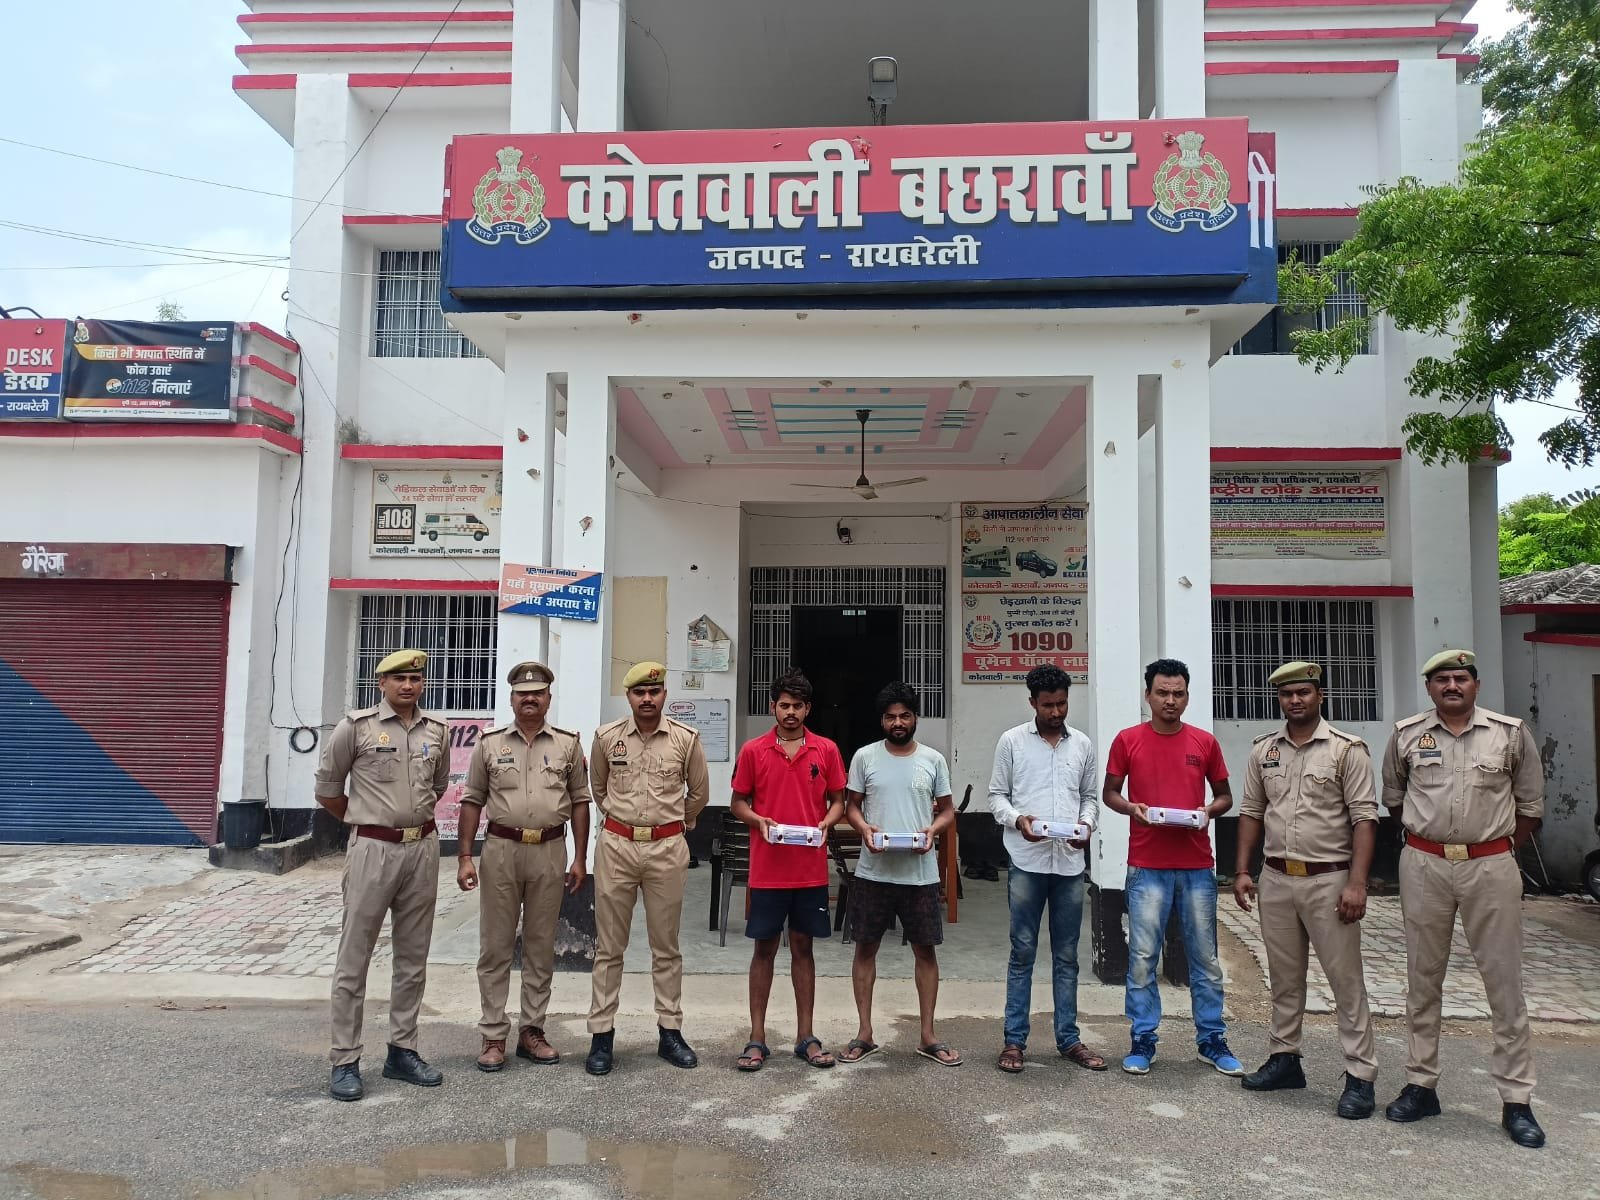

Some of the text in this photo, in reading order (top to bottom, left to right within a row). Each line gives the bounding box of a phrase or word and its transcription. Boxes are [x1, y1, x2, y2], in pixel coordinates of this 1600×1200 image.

[560, 138, 870, 231] कोतवाली
[890, 131, 1137, 225] बछरावाँ
[496, 222, 521, 234] प्रदेश
[705, 245, 806, 270] जनपद
[845, 235, 982, 268] रायबरेली
[6, 348, 54, 366] DESK
[94, 347, 206, 360] किसी भी आपात स्थिति में
[126, 363, 172, 376] फोन उठाएं
[3, 367, 52, 391] डेस्क
[121, 378, 192, 395] 112 मिलाएं
[6, 398, 49, 412] रायबरेली
[1262, 476, 1278, 484] सेवा
[1260, 483, 1304, 495] लोक
[1309, 485, 1379, 495] अदालत
[383, 508, 412, 529] 108
[983, 505, 1085, 520] आपातकालीन सेवा
[376, 546, 409, 554] कोतवाली
[568, 585, 595, 596] करना
[968, 581, 1002, 589] कोतवाली
[503, 594, 543, 606] दण्डनीय
[1040, 597, 1050, 605] के
[1053, 596, 1081, 606] विरुद्ध
[1031, 619, 1053, 627] कॉल
[1055, 618, 1072, 627] करें
[1008, 632, 1073, 651] 1090
[973, 653, 1013, 670] वूमेन
[1017, 653, 1057, 667] पॉवर
[968, 672, 1003, 681] कोतवाली
[449, 724, 479, 748] 112
